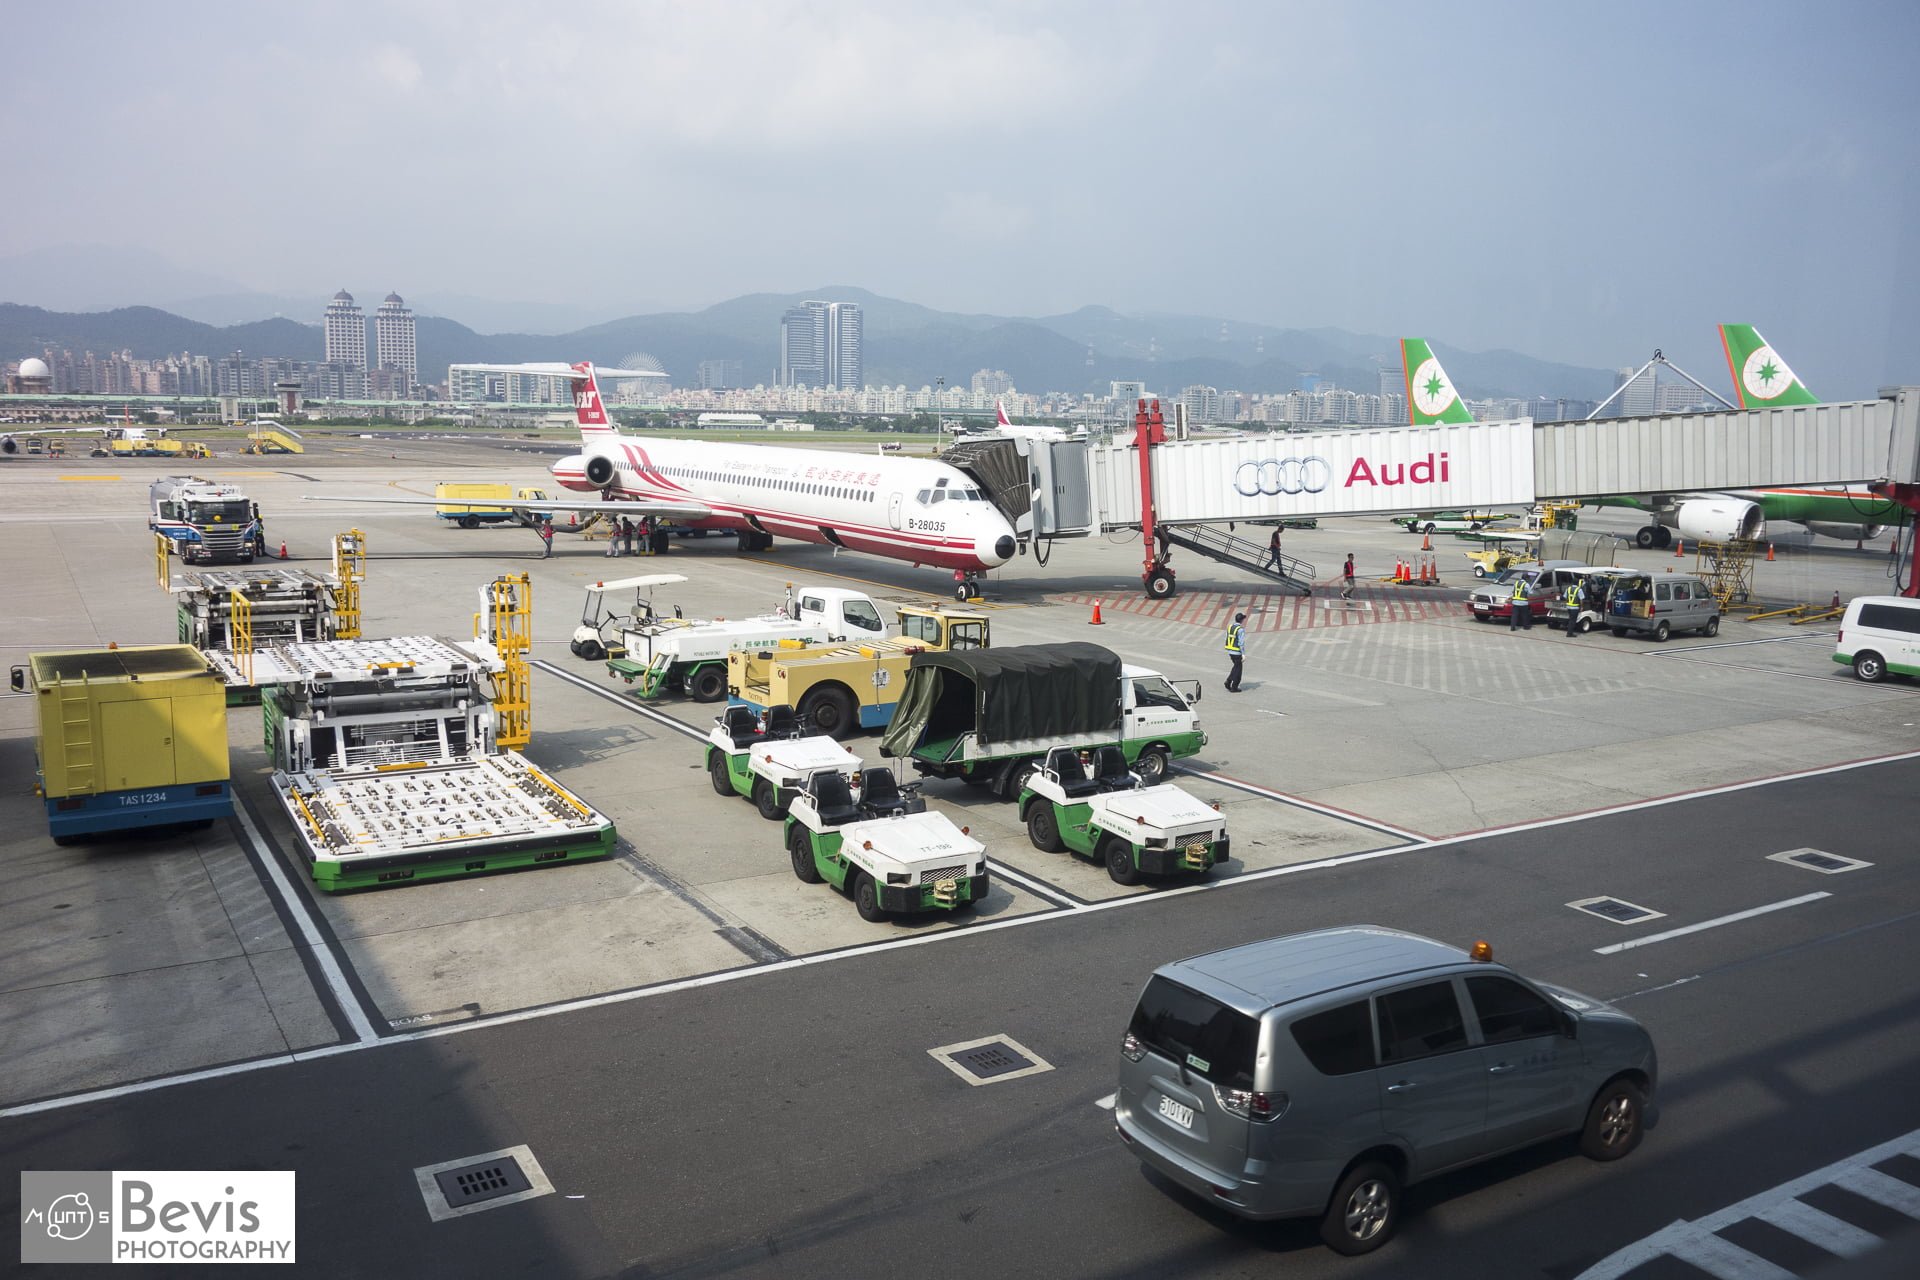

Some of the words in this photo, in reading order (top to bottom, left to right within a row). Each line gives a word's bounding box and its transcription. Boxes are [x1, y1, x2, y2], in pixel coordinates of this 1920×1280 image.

[575, 391, 597, 409] FAT
[1344, 452, 1449, 488] Audi
[908, 518, 946, 532] B-28035
